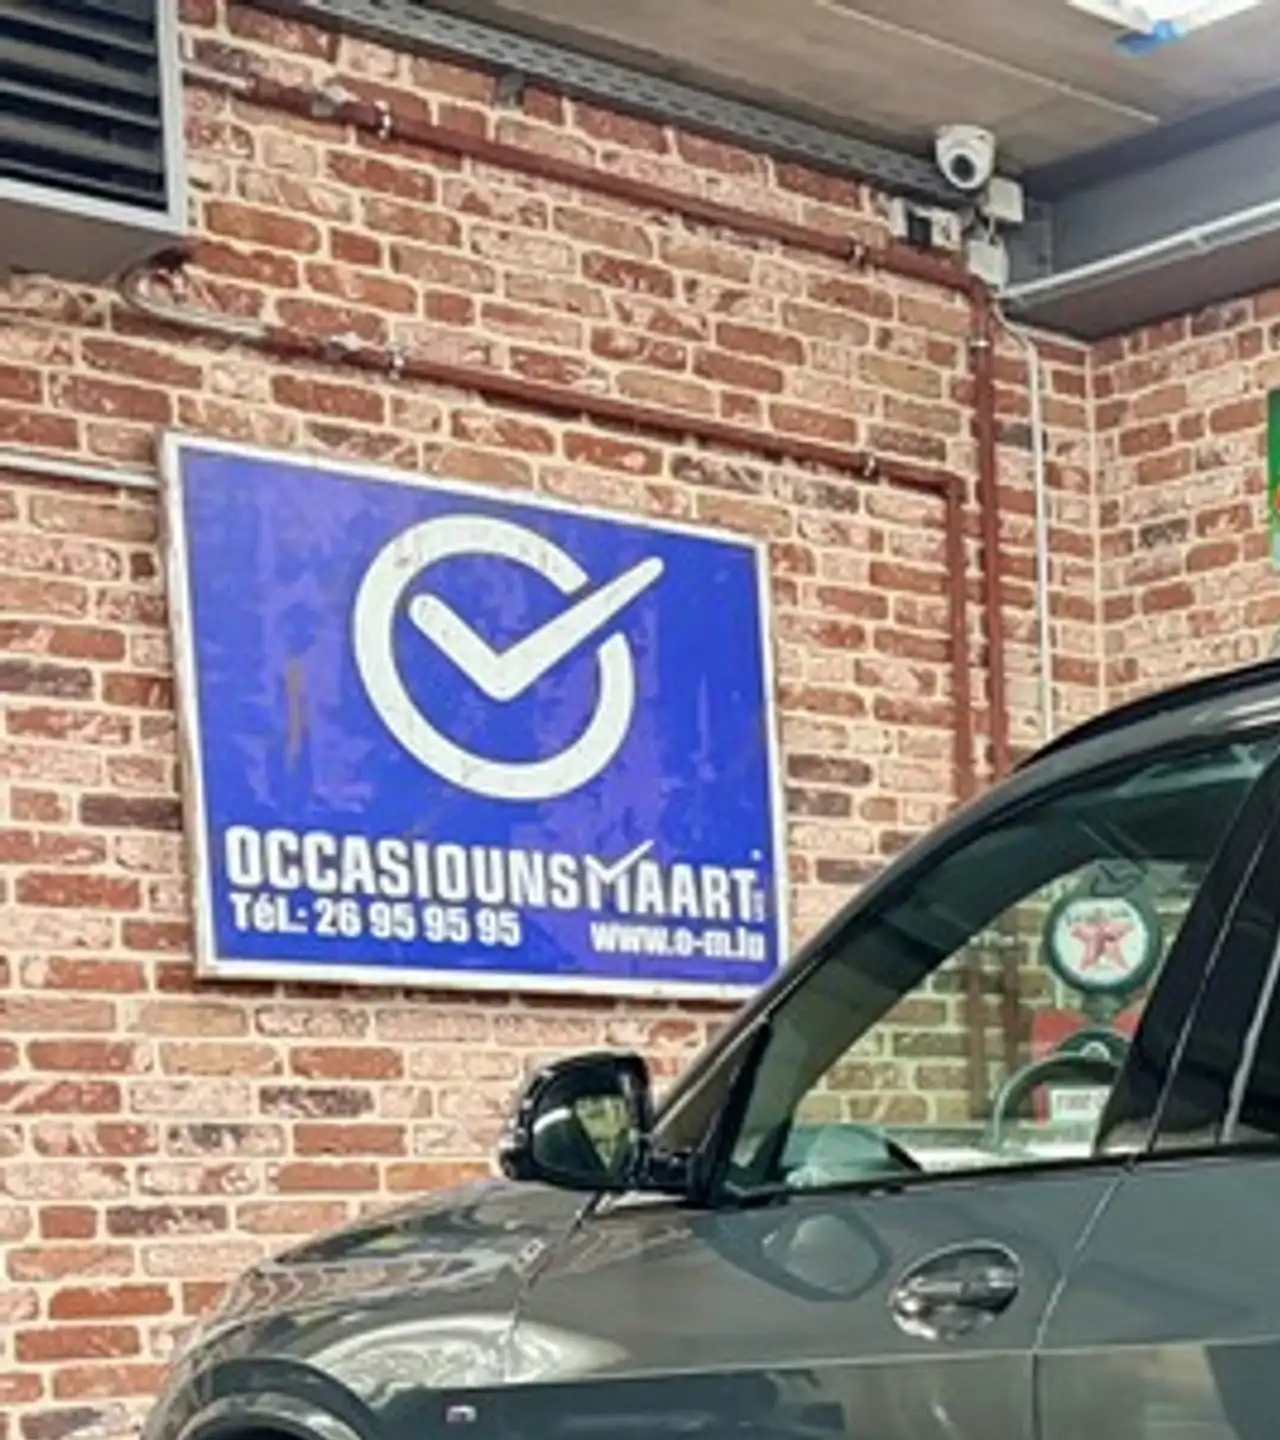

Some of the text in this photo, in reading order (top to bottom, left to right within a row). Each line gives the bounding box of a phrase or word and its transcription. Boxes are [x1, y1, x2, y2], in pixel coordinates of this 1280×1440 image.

[225, 825, 757, 922] OCCASIOUNSMAART
[313, 898, 362, 938] 26
[368, 902, 417, 942] 95
[423, 905, 471, 944] 95
[476, 908, 522, 948] 95
[590, 921, 766, 961] www.o-m.lu
